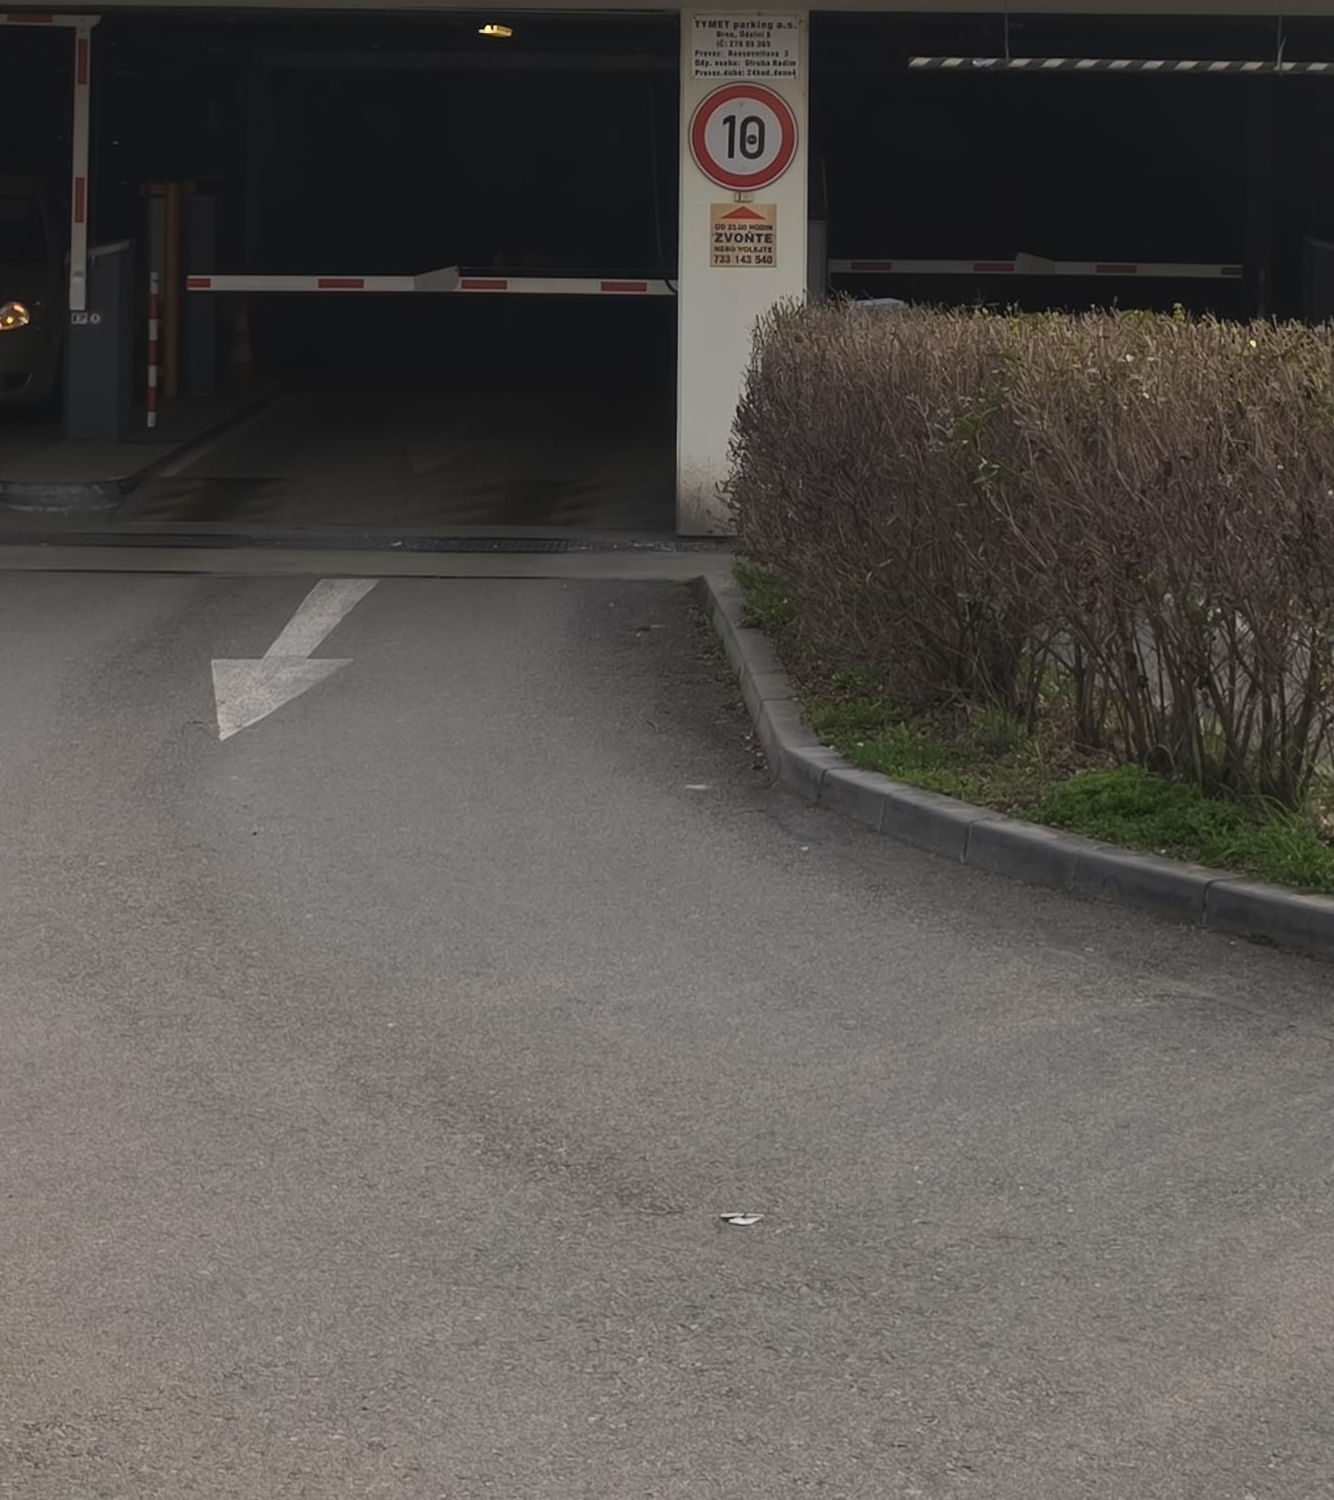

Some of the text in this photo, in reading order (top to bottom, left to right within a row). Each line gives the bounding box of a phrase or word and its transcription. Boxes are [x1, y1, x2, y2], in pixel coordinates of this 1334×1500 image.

[695, 20, 730, 29] TYMET
[733, 20, 774, 30] parking
[722, 114, 766, 160] 10
[714, 223, 727, 231] OD
[714, 231, 773, 244] ZVOŇTE
[714, 245, 773, 253] NEBO VOLEJTE
[735, 254, 753, 264] 143
[755, 254, 773, 265] 540
